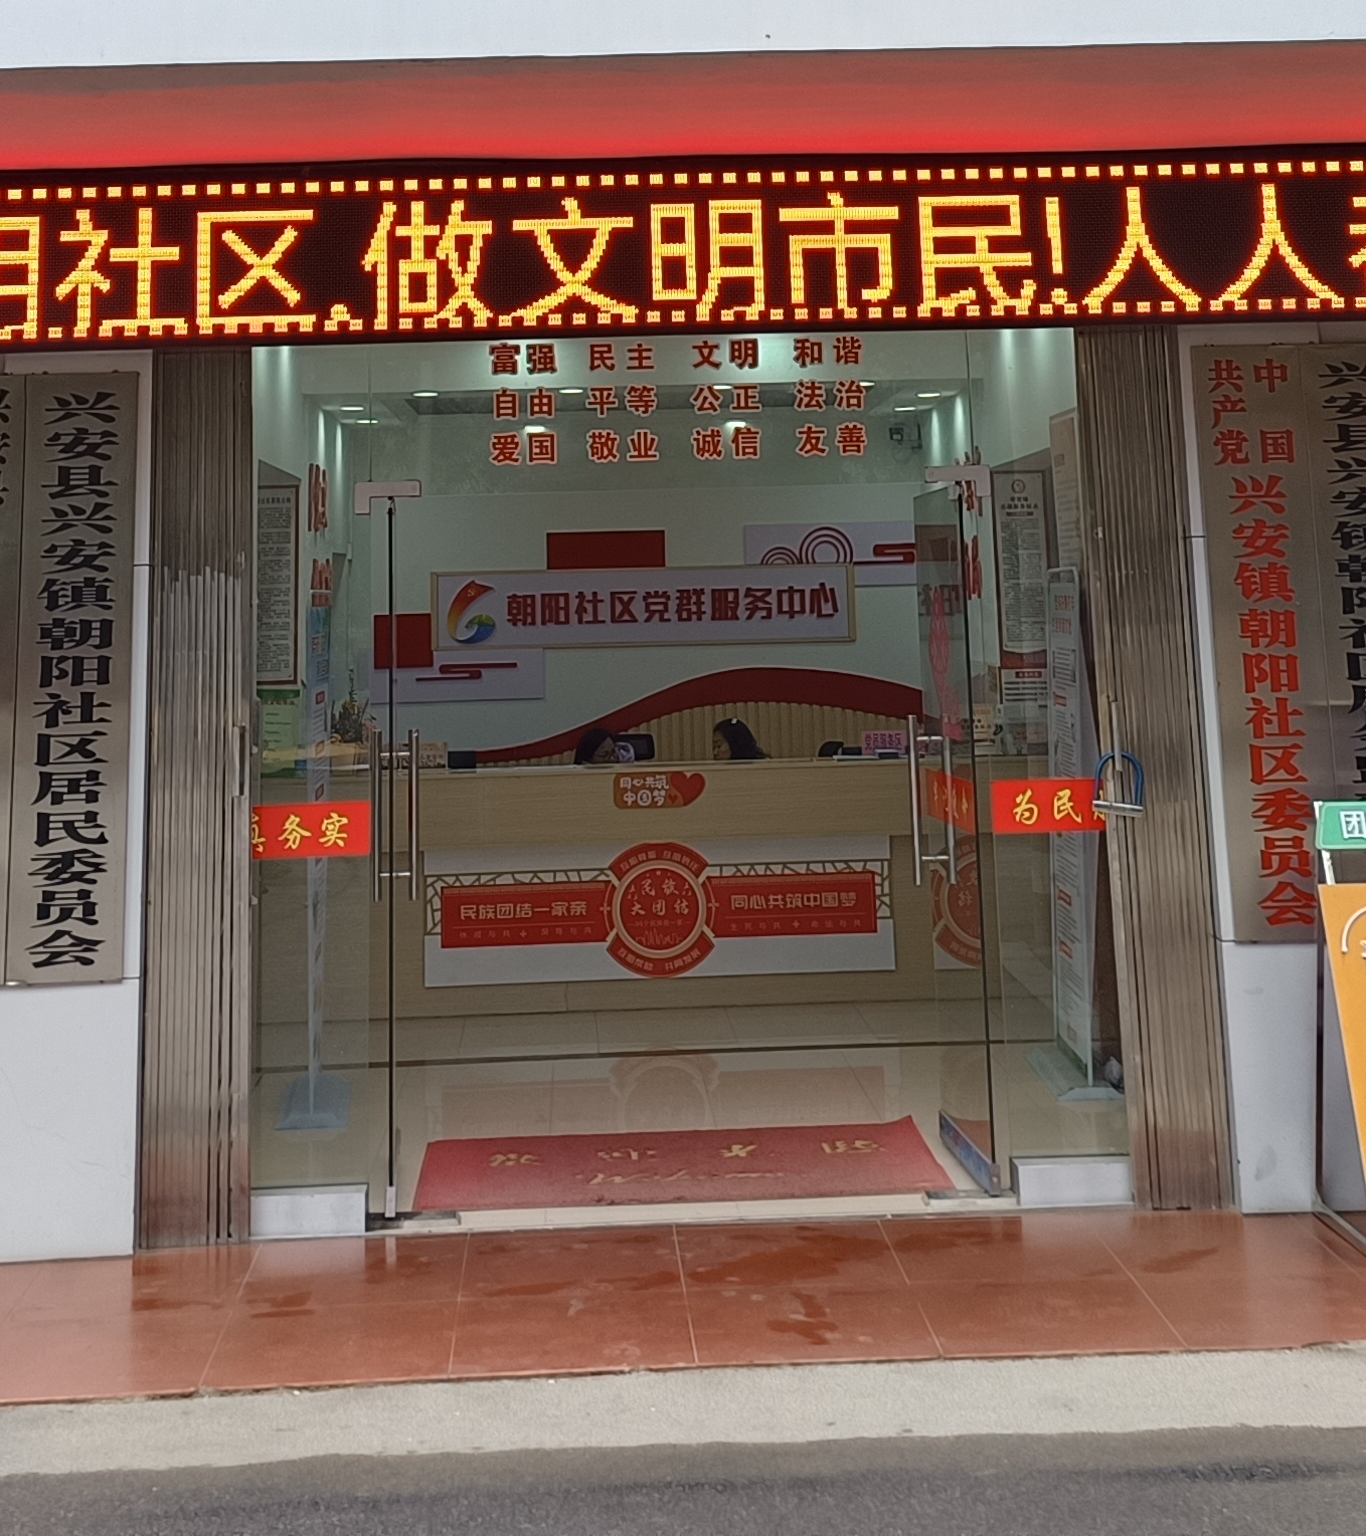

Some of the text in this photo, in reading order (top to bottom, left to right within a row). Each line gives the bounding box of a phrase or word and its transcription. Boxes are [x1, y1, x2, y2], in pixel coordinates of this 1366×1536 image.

[489, 336, 863, 375] 富强 民主 文明 和谐
[493, 380, 865, 419] 自由 平等 公正 法治
[1207, 358, 1251, 466] 共产党
[491, 423, 866, 464] 爱国 敬业 诚信 友善
[506, 581, 840, 627] 朝阳社区党群服务中心
[24, 391, 121, 968] 兴安县兴安镇朝阳社区居民委员会
[1229, 473, 1318, 929] 兴安镇朝阳社区委员会
[620, 775, 669, 790] 同心共筑
[623, 790, 666, 807] 中国梦
[1013, 789, 1106, 826] 为民
[641, 878, 679, 896] 民族
[730, 892, 857, 910] 同心共筑中国梦
[460, 901, 588, 920] 民族团结一家亲
[631, 898, 689, 916] 大团结
